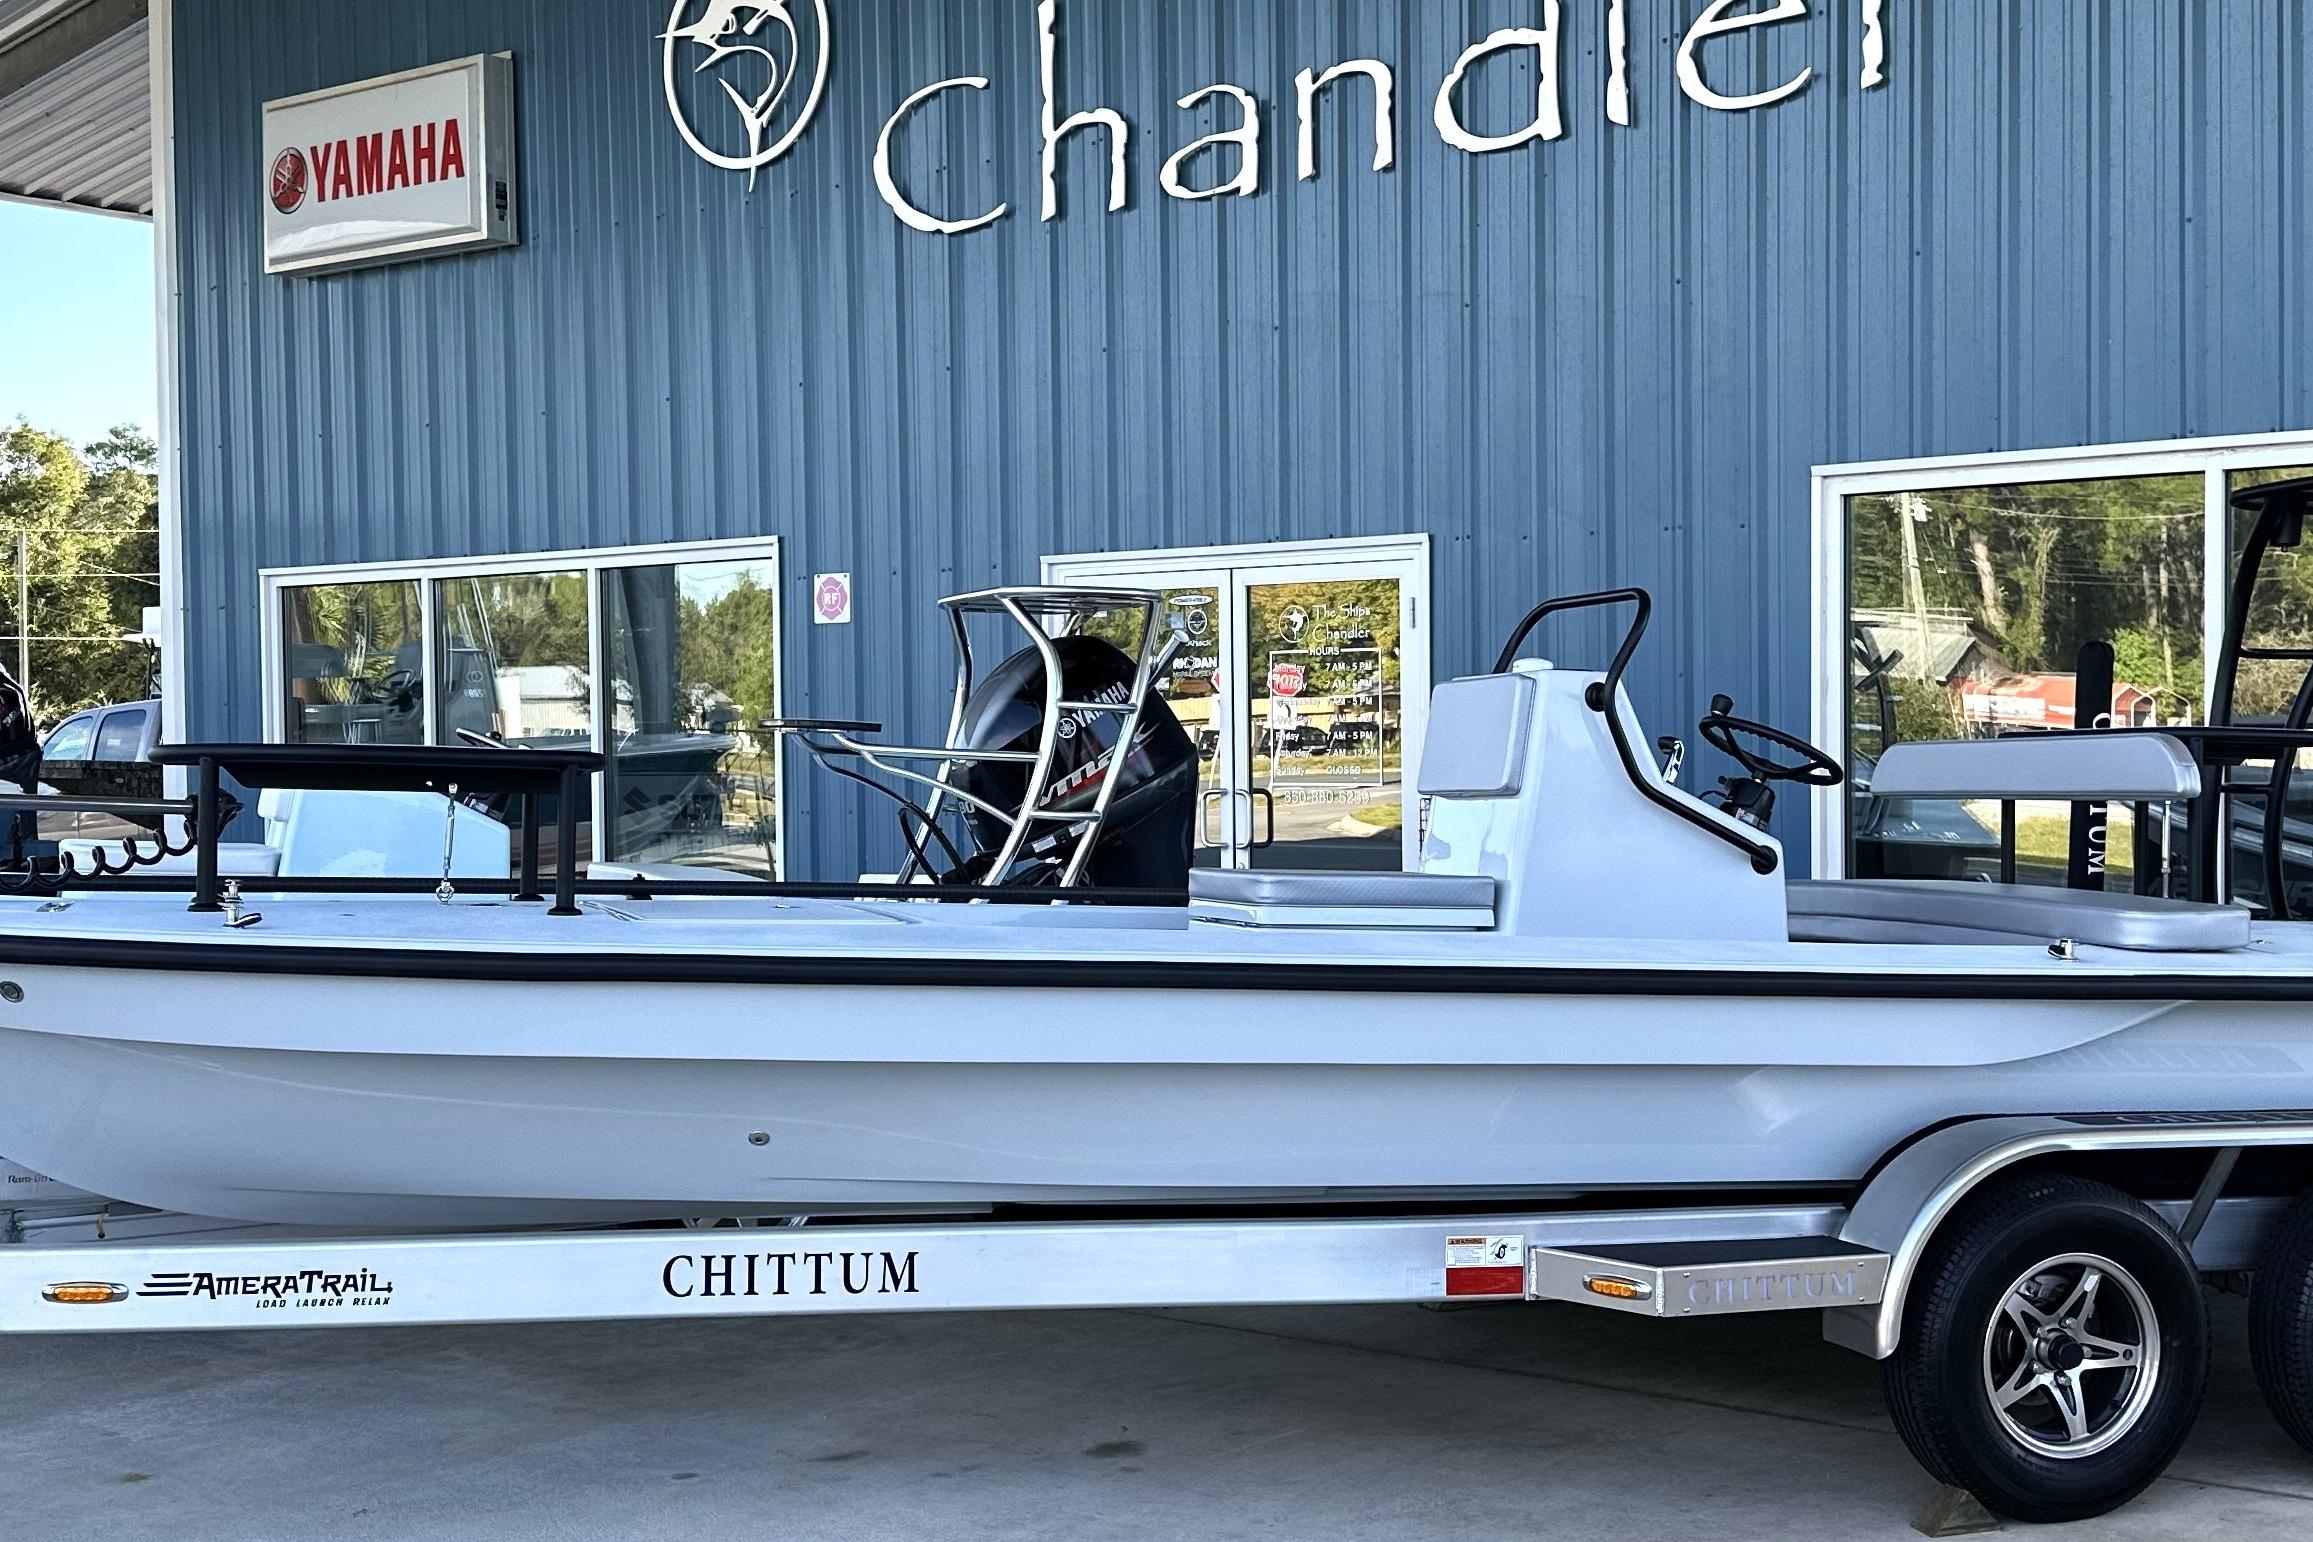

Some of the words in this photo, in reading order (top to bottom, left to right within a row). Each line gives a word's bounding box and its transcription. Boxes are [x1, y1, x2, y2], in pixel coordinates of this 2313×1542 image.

[309, 119, 465, 203] YAMAHA
[824, 592, 840, 606] RF
[1312, 604, 1336, 620] The
[1312, 623, 1371, 642] Chandler
[1309, 647, 1340, 656] HOURS
[1332, 663, 1346, 671] AM
[1360, 662, 1373, 670] PM
[1332, 680, 1346, 688] AM
[1360, 697, 1373, 705] PM
[1333, 732, 1346, 740] AM
[1352, 732, 1358, 740] 5
[1360, 731, 1373, 739] PM
[1276, 749, 1310, 759] aturday
[1333, 749, 1346, 757] AM
[1364, 748, 1378, 757] PM
[1326, 766, 1361, 775] CLOSED
[662, 1252, 919, 1298] CHITTUM
[1688, 1270, 1856, 1305] CHITTUM
[256, 1299, 287, 1309] LOAD
[296, 1298, 343, 1308] LAUNCH
[352, 1297, 391, 1306] RELAX
